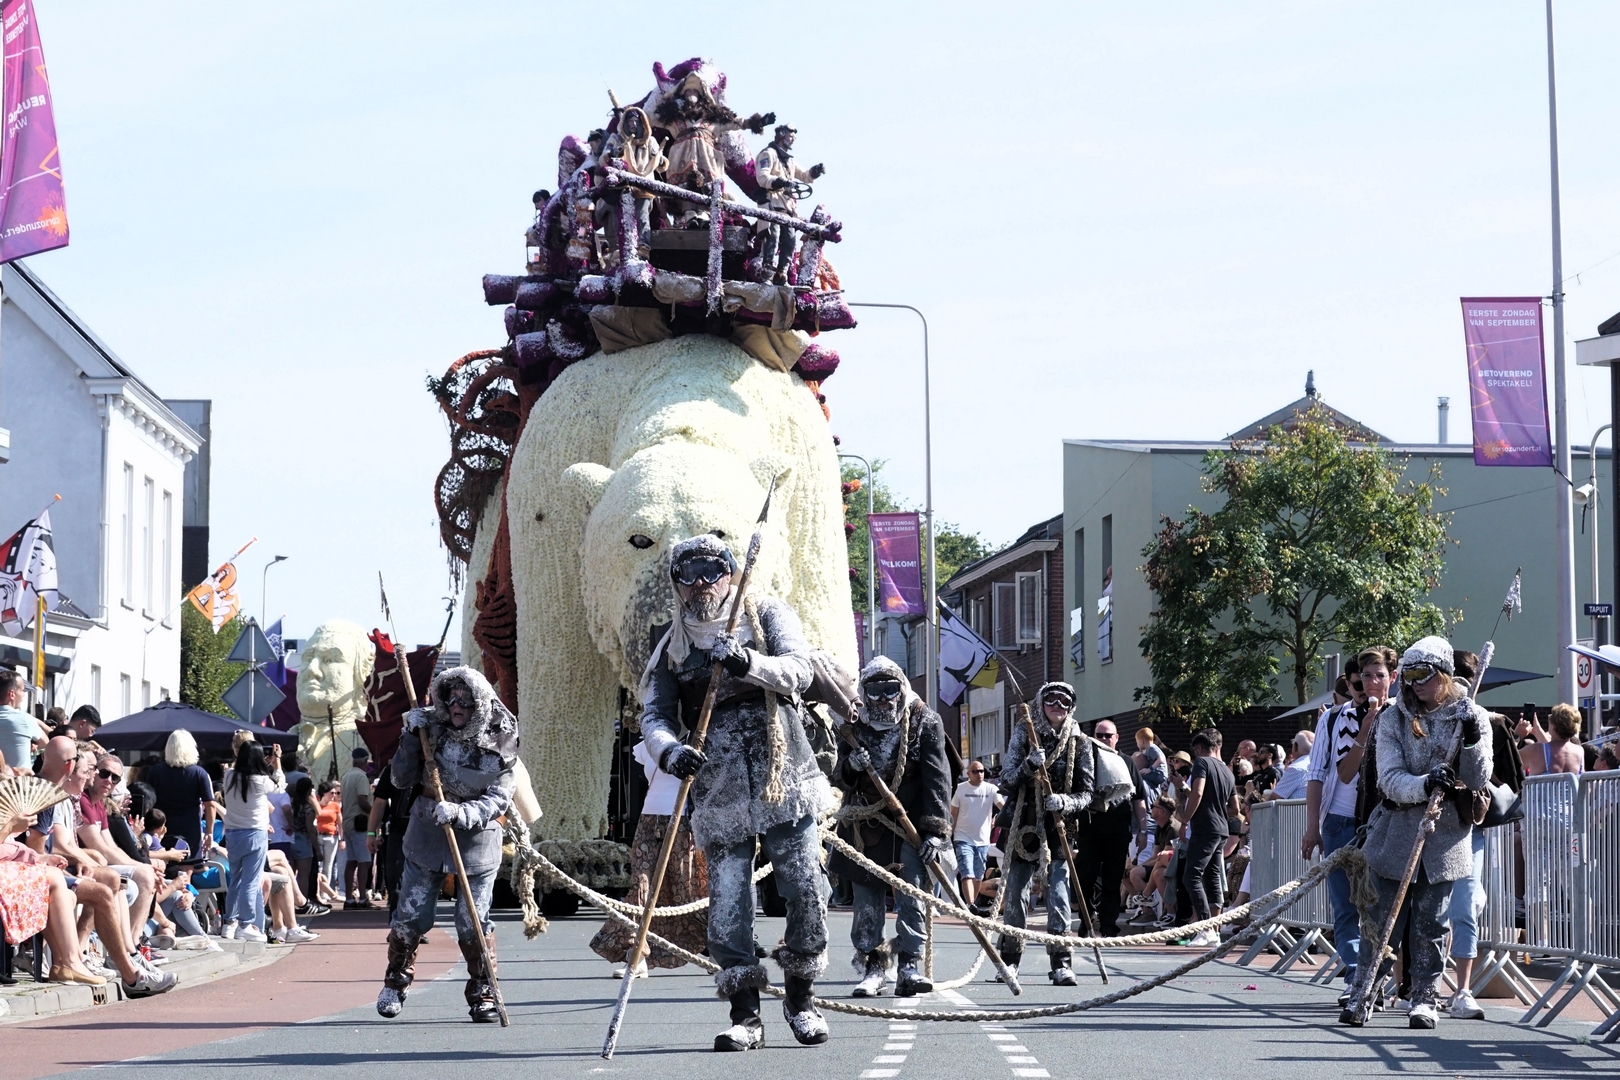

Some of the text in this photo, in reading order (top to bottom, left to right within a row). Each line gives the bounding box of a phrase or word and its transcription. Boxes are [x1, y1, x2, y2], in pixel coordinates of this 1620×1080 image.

[1469, 309, 1535, 317] EERSTE ZONDAG
[880, 559, 917, 568] WELKOM!
[1579, 664, 1589, 676] 30
